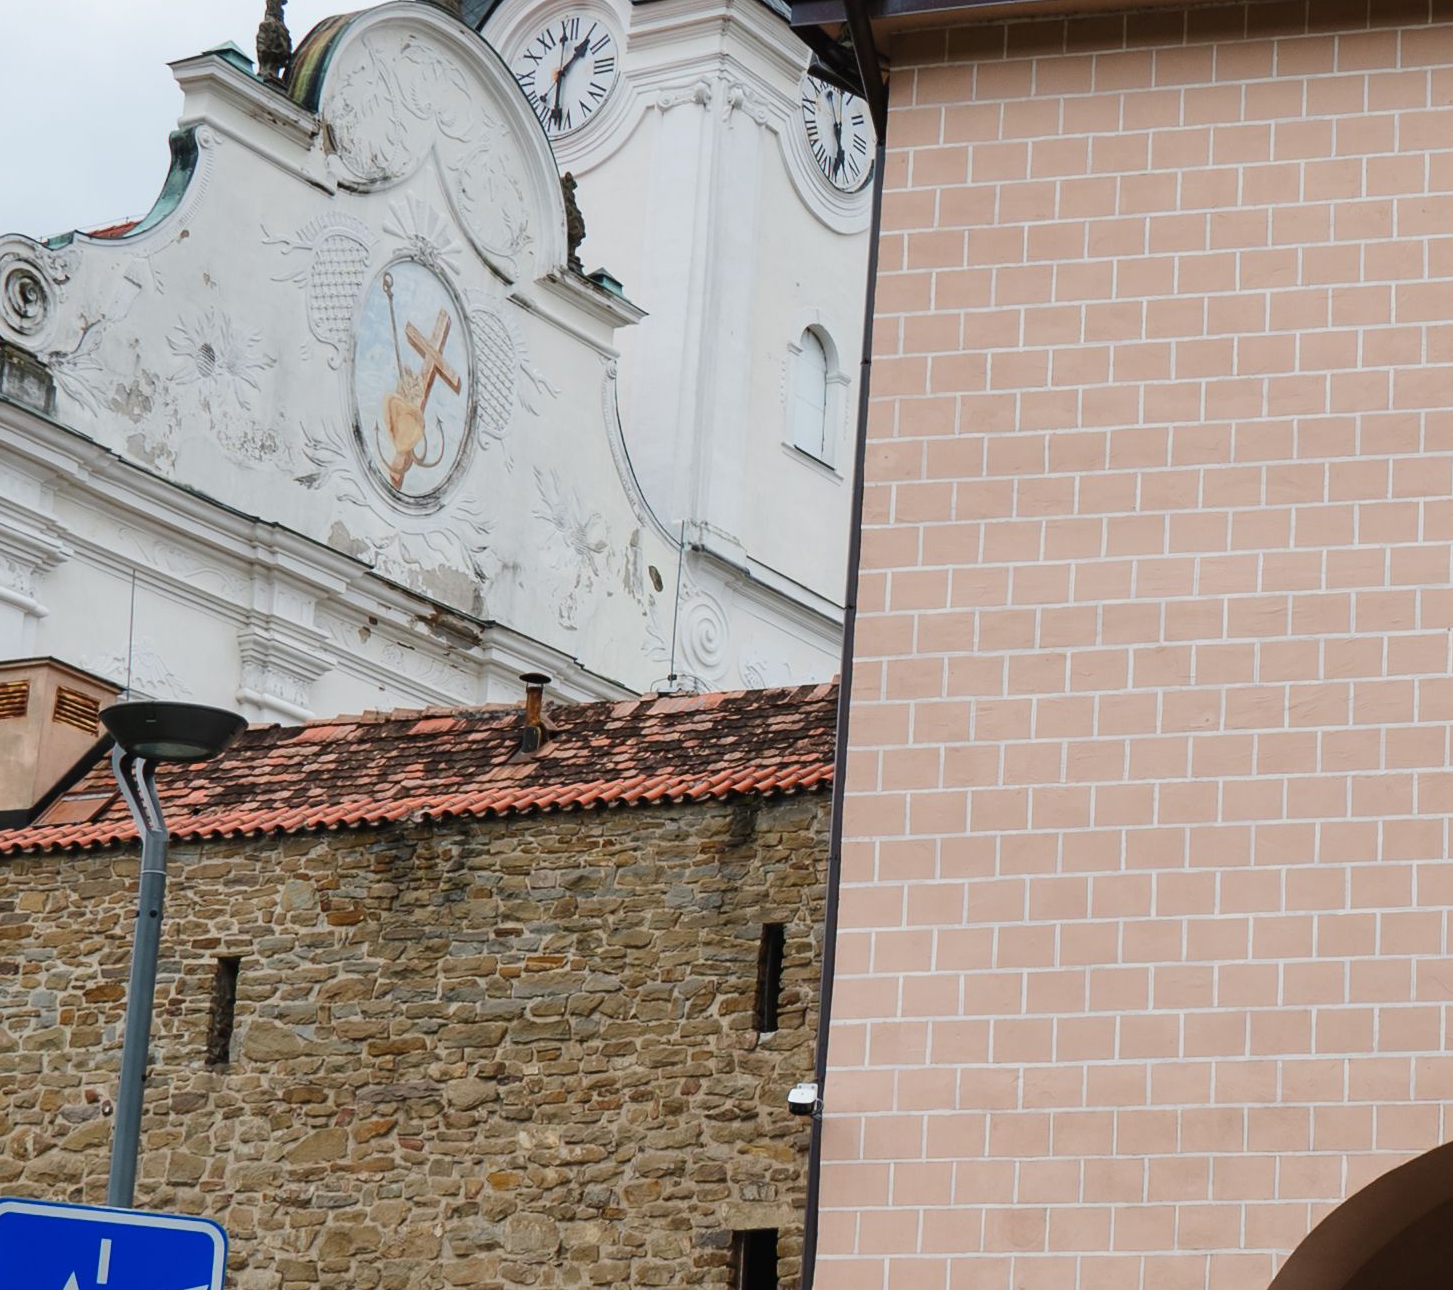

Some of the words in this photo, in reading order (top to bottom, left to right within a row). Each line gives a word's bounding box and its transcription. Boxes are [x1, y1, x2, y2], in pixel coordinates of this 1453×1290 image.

[536, 28, 556, 55] XI
[589, 33, 611, 55] II
[523, 48, 543, 66] X
[593, 56, 615, 75] III
[587, 82, 607, 104] IV
[578, 99, 592, 118] V
[851, 114, 864, 126] II
[853, 132, 866, 155] III
